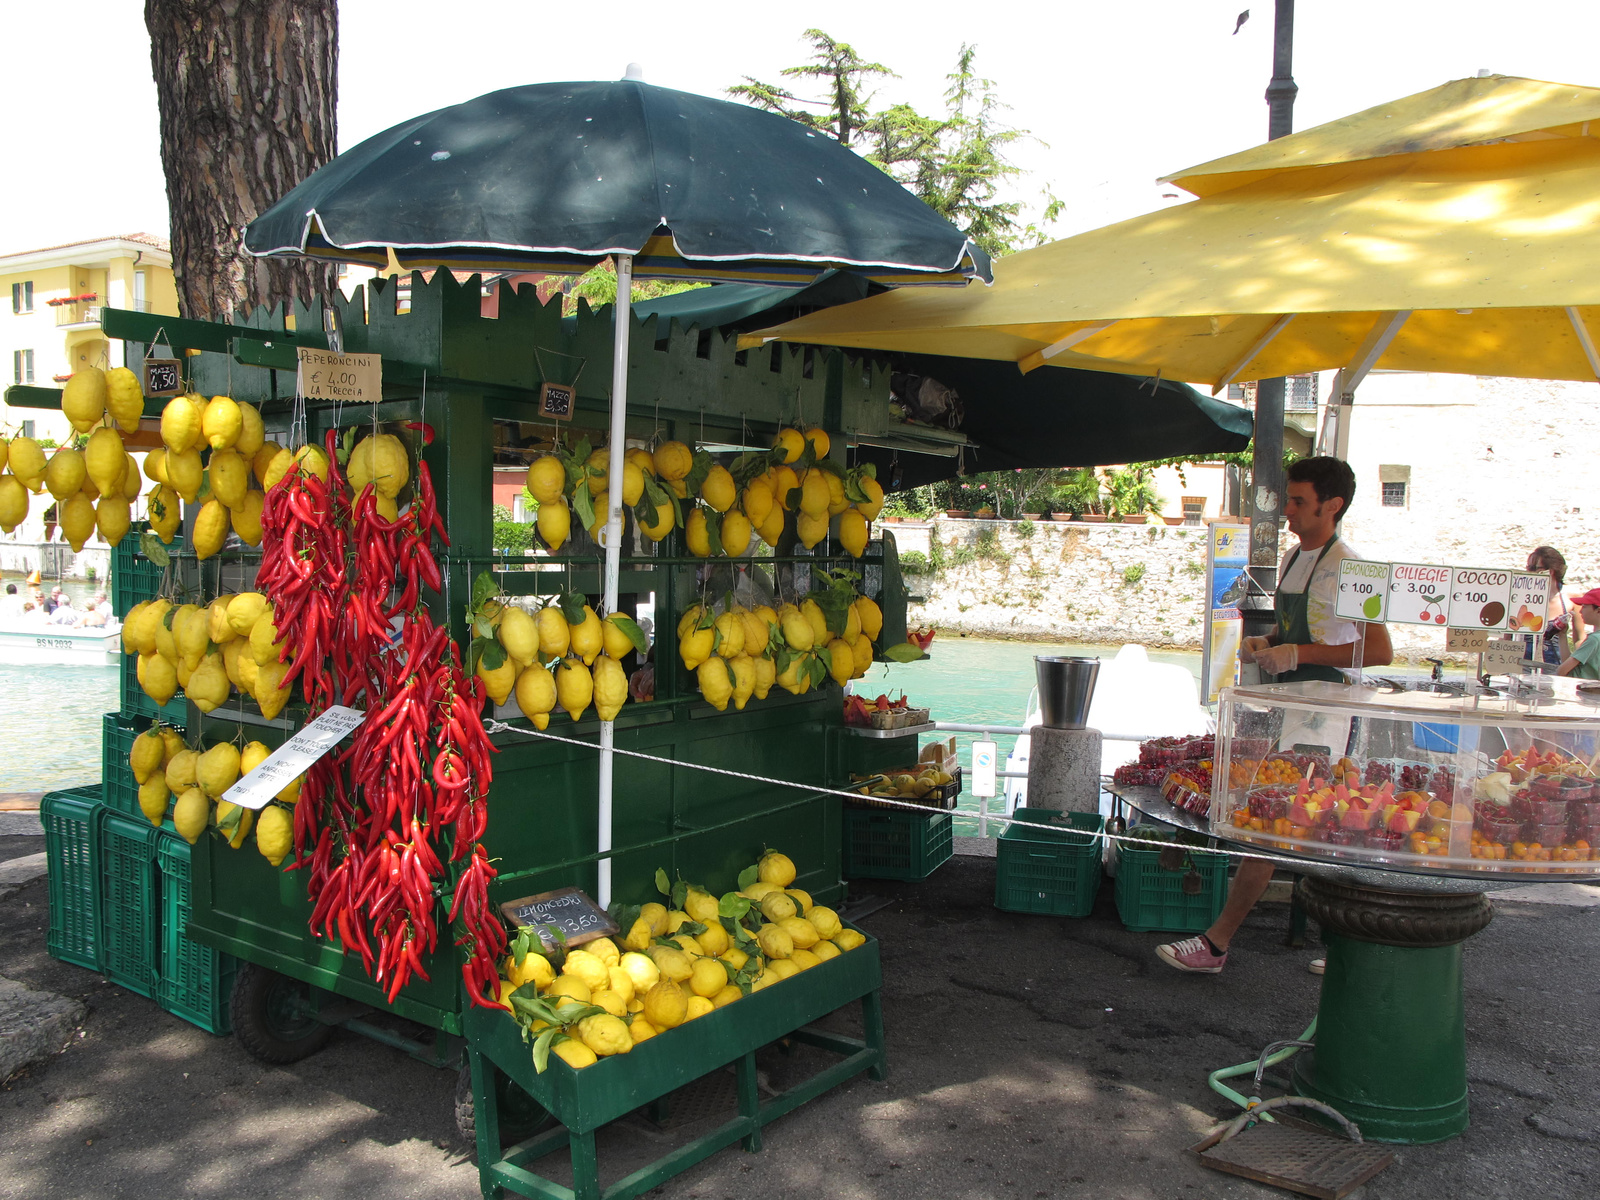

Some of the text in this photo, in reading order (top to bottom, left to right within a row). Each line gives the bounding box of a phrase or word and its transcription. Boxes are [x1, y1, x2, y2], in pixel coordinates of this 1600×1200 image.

[310, 371, 357, 386] € 4.00
[310, 386, 320, 395] LA
[1342, 562, 1388, 579] LEMONCEDRO
[1395, 566, 1449, 583] CILIEGIE
[1457, 571, 1507, 586] COCCO
[1340, 582, 1373, 594] € 1.00
[1390, 582, 1436, 595] € 3.00
[1452, 591, 1488, 603] € 1.00
[1525, 594, 1544, 604] 3.00
[1454, 629, 1475, 637] BOX
